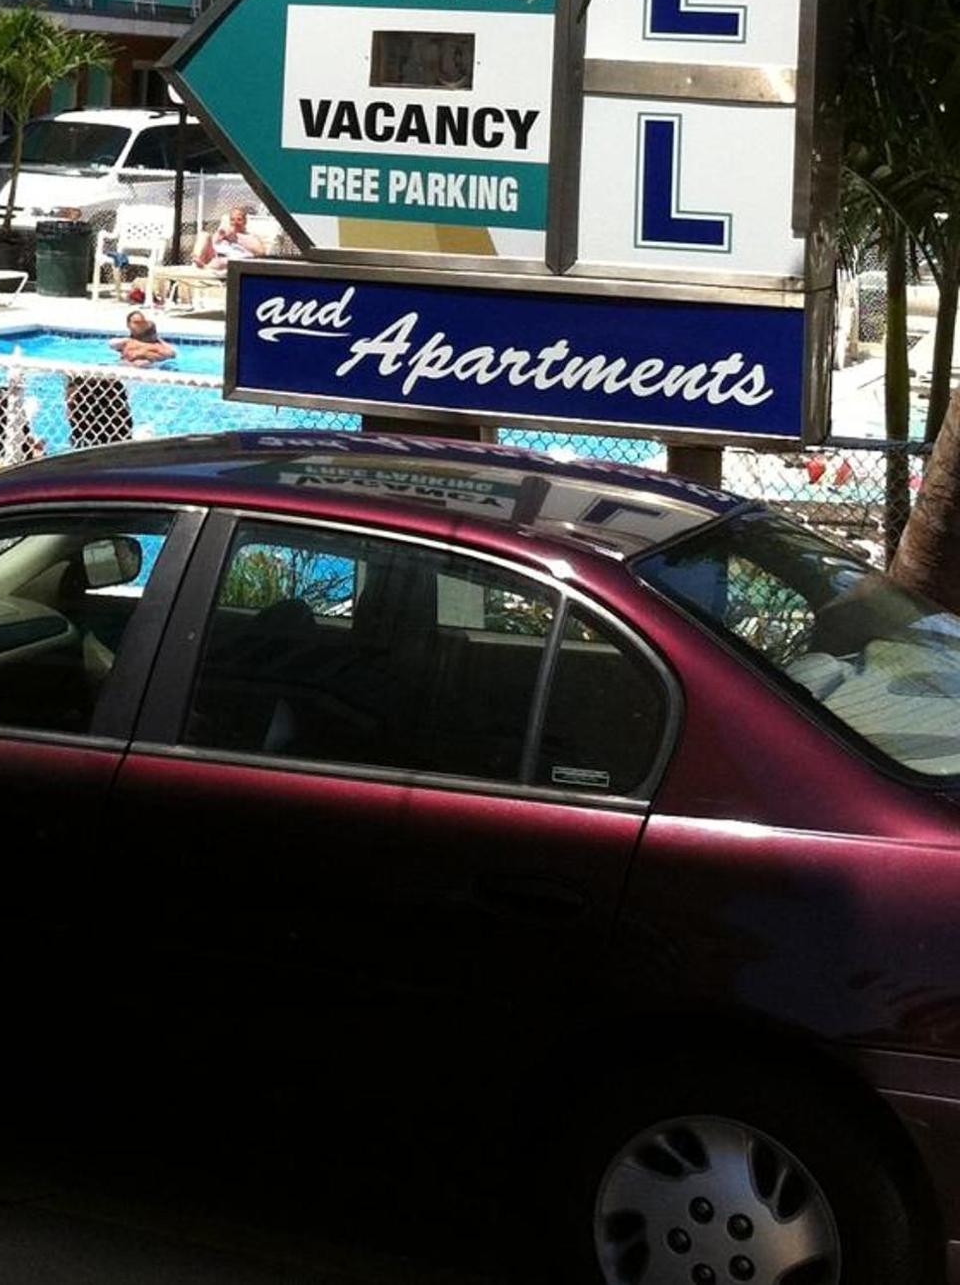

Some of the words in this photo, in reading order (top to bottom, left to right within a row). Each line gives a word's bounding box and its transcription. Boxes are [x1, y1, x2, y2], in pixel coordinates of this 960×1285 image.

[299, 98, 540, 150] VACANCY
[310, 165, 380, 203] FREE
[388, 169, 519, 212] PARKING
[256, 287, 356, 328] and
[336, 312, 774, 407] Apartments
